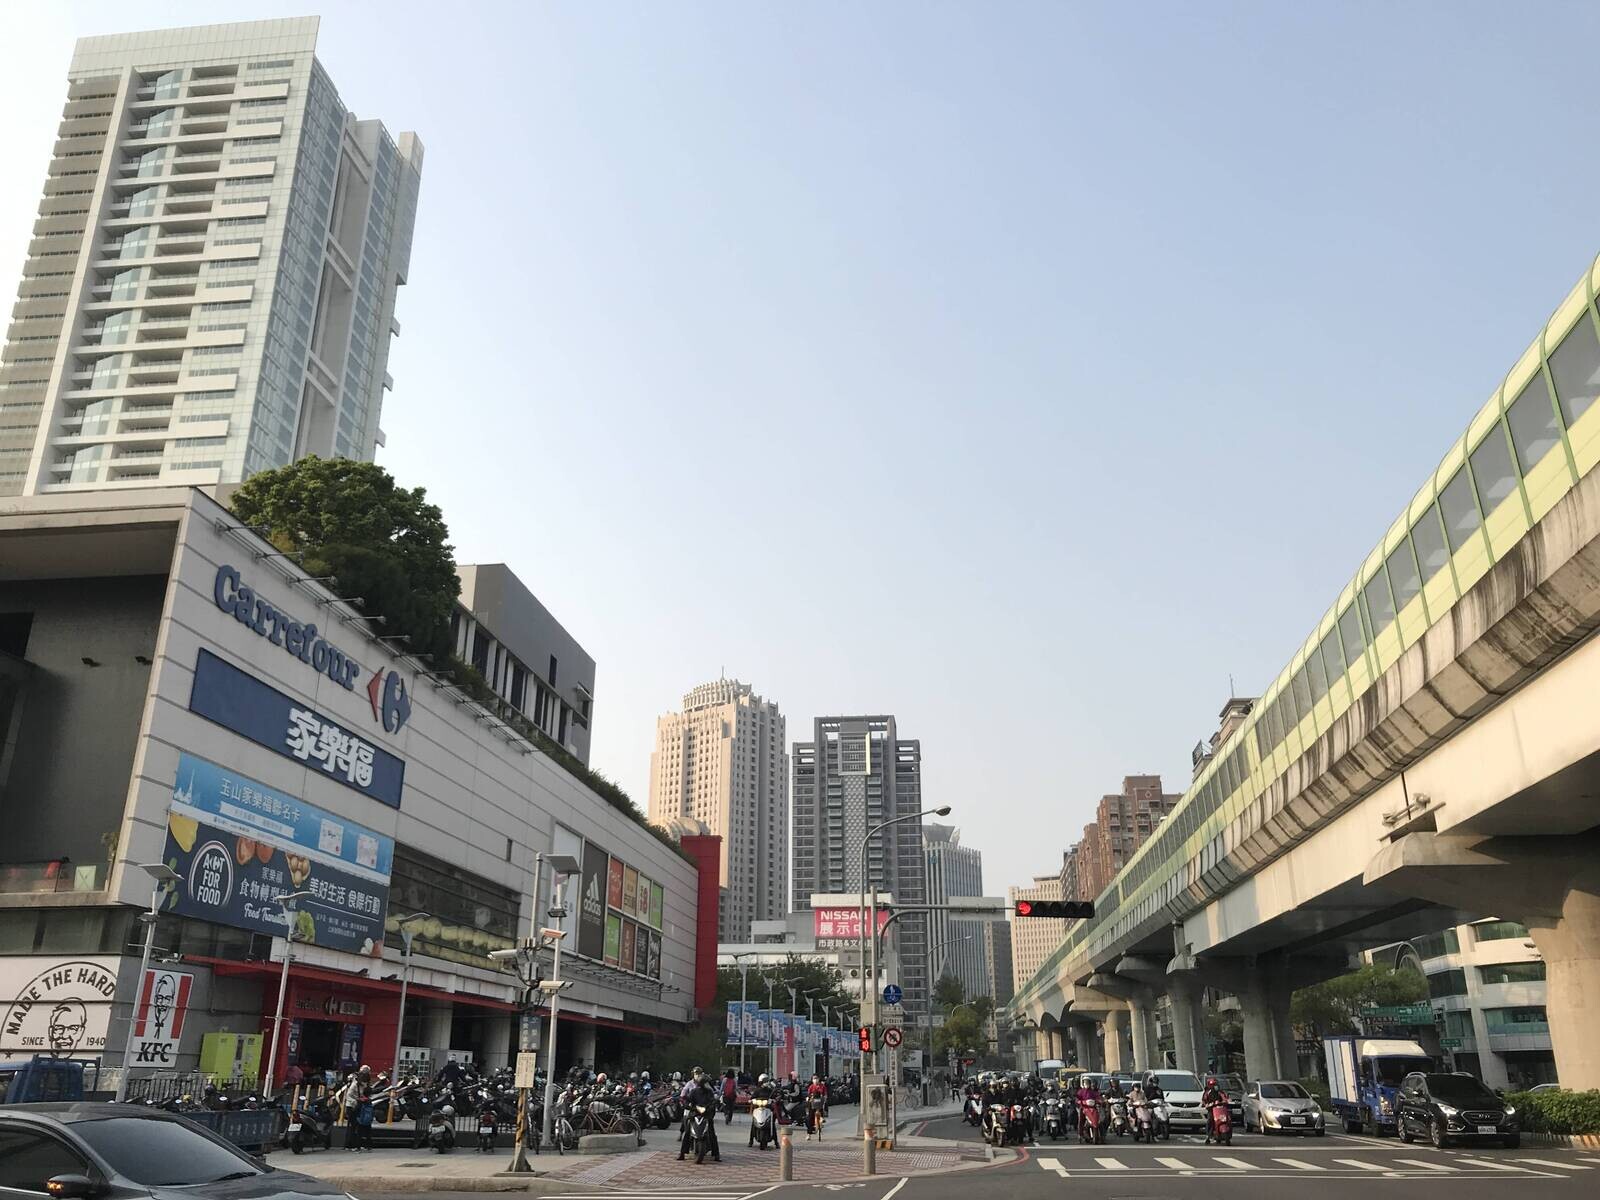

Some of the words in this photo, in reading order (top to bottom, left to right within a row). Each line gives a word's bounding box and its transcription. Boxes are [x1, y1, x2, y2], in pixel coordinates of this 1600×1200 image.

[214, 564, 361, 692] Carrefour
[285, 706, 376, 788] 家樂福
[202, 870, 221, 889] FOR
[196, 885, 221, 906] FOOD
[583, 897, 602, 917] adidas
[820, 910, 868, 920] NISSAN
[6, 986, 41, 1035] MADE
[42, 968, 73, 991] THE
[77, 967, 116, 997] HARD
[21, 1036, 45, 1046] SINCE
[86, 1036, 106, 1046] 1940
[136, 1041, 173, 1063] KFC
